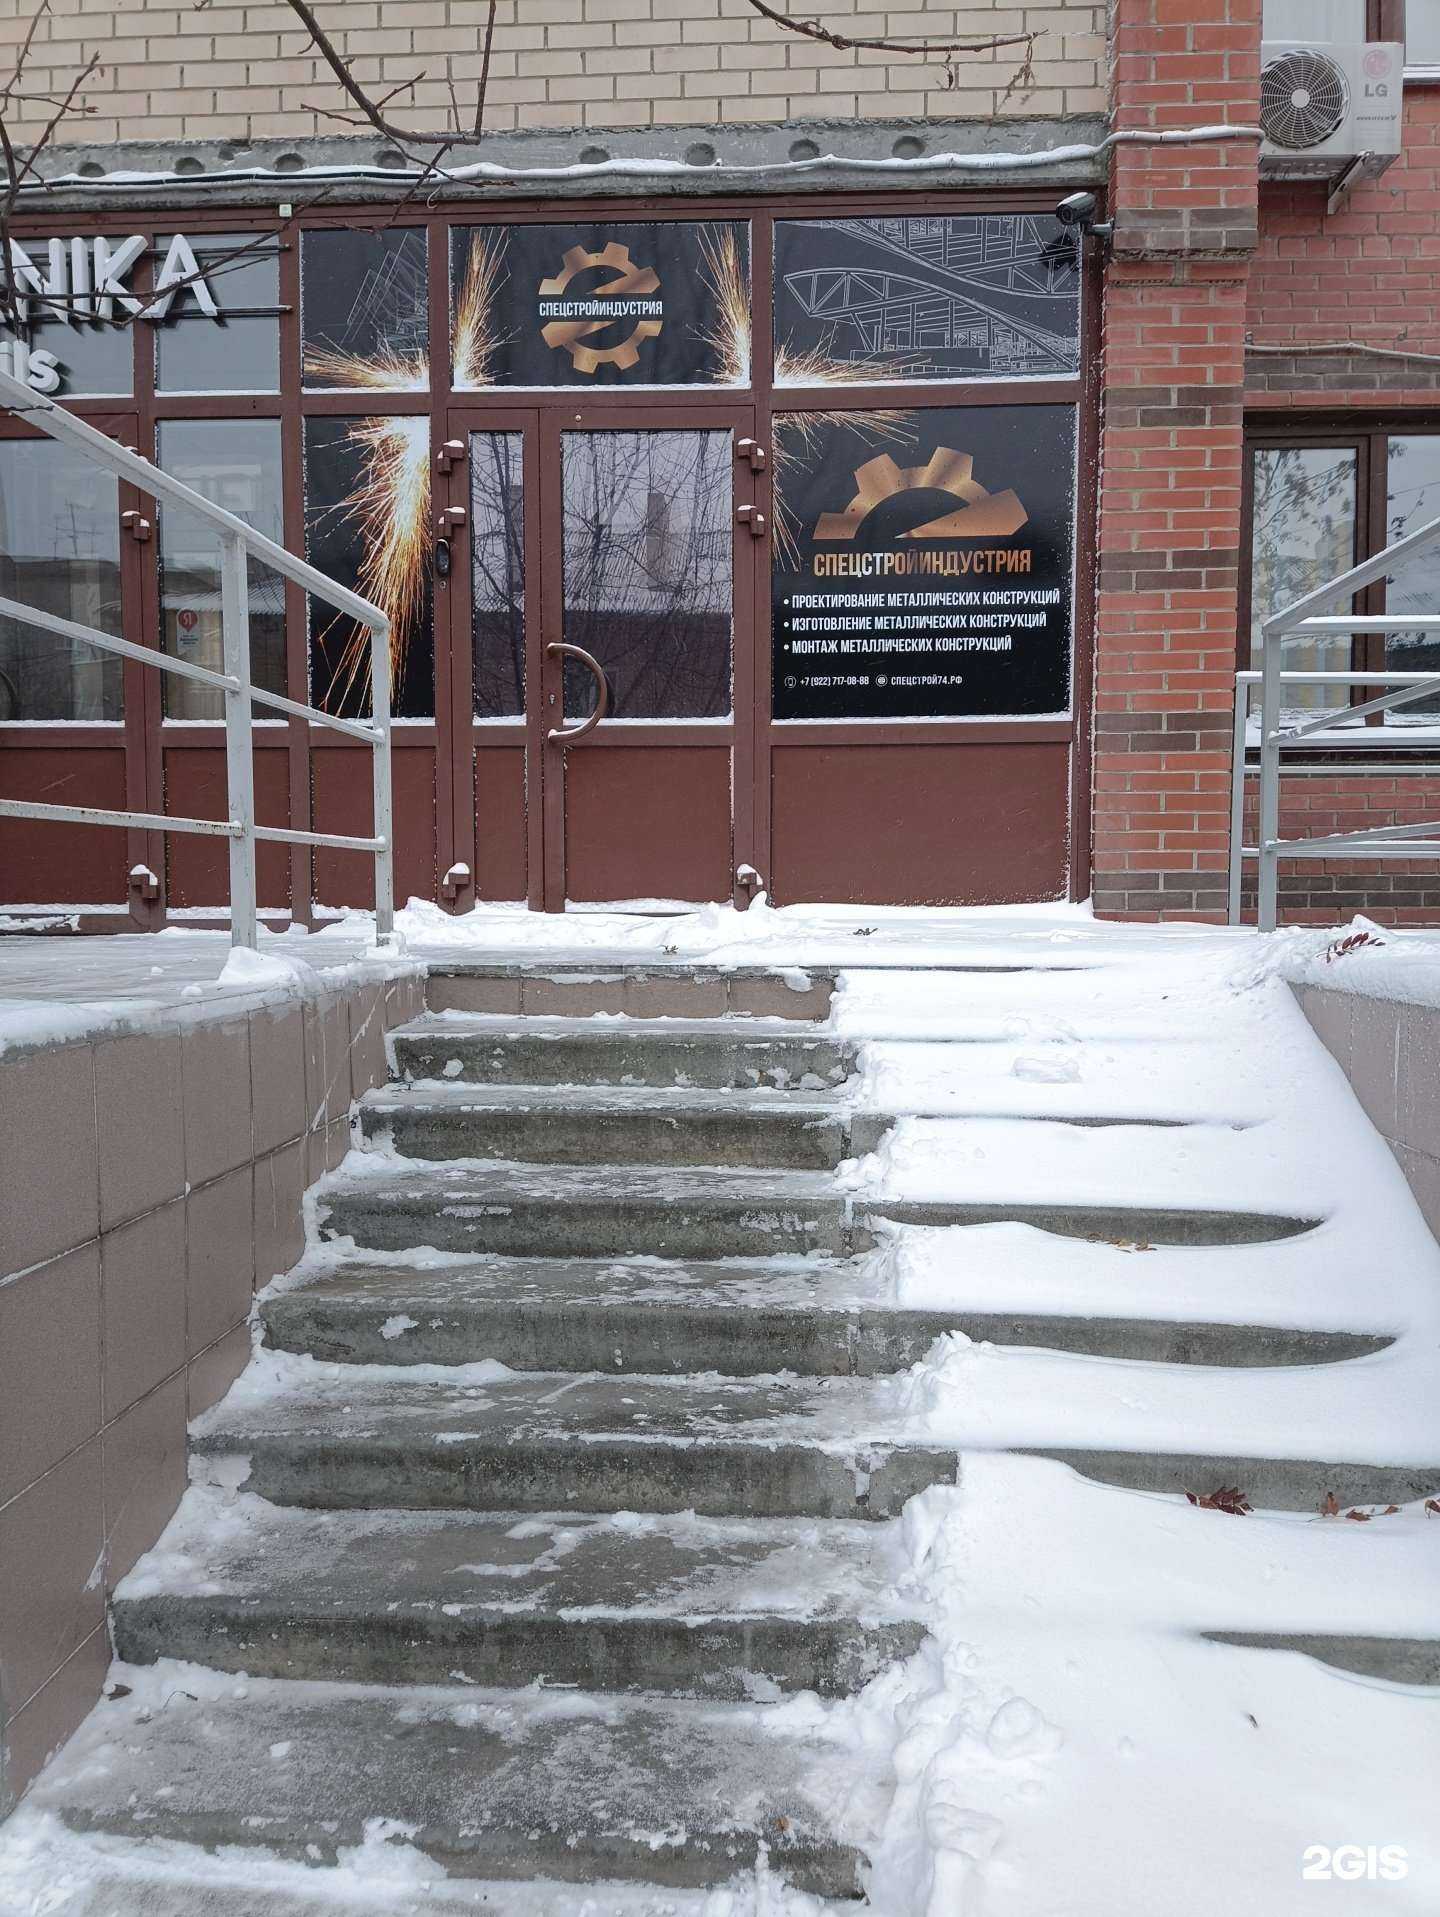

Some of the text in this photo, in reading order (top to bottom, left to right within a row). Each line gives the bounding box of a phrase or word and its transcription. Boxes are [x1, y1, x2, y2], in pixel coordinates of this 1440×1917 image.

[1364, 83, 1388, 97] LG
[0, 234, 217, 324] NIKA
[539, 300, 663, 317] СПЕЦСТРОЙИНДУСТРИЯ
[813, 549, 1031, 578] СПЕЦСТРОЙИНДУСТРИЯ
[791, 588, 1060, 609] ПРОЕКТИРОВАНИЕ МЕТАЛЛИЧЕСКИХ КОНСТРУКЦИЙ
[791, 611, 1047, 631] ИЗГОТОВЛЕНИЕ МЕТАЛЛИЧЕСКИХ КОНСТРУКЦИЙ
[791, 634, 1012, 654] МОНТАЖ МЕТАЛЛИЧЕСКИХ КОНСТРУКЦИЙ
[800, 677, 810, 687] +7
[891, 674, 963, 686] СПЕЦСТРОЙ74.РФ
